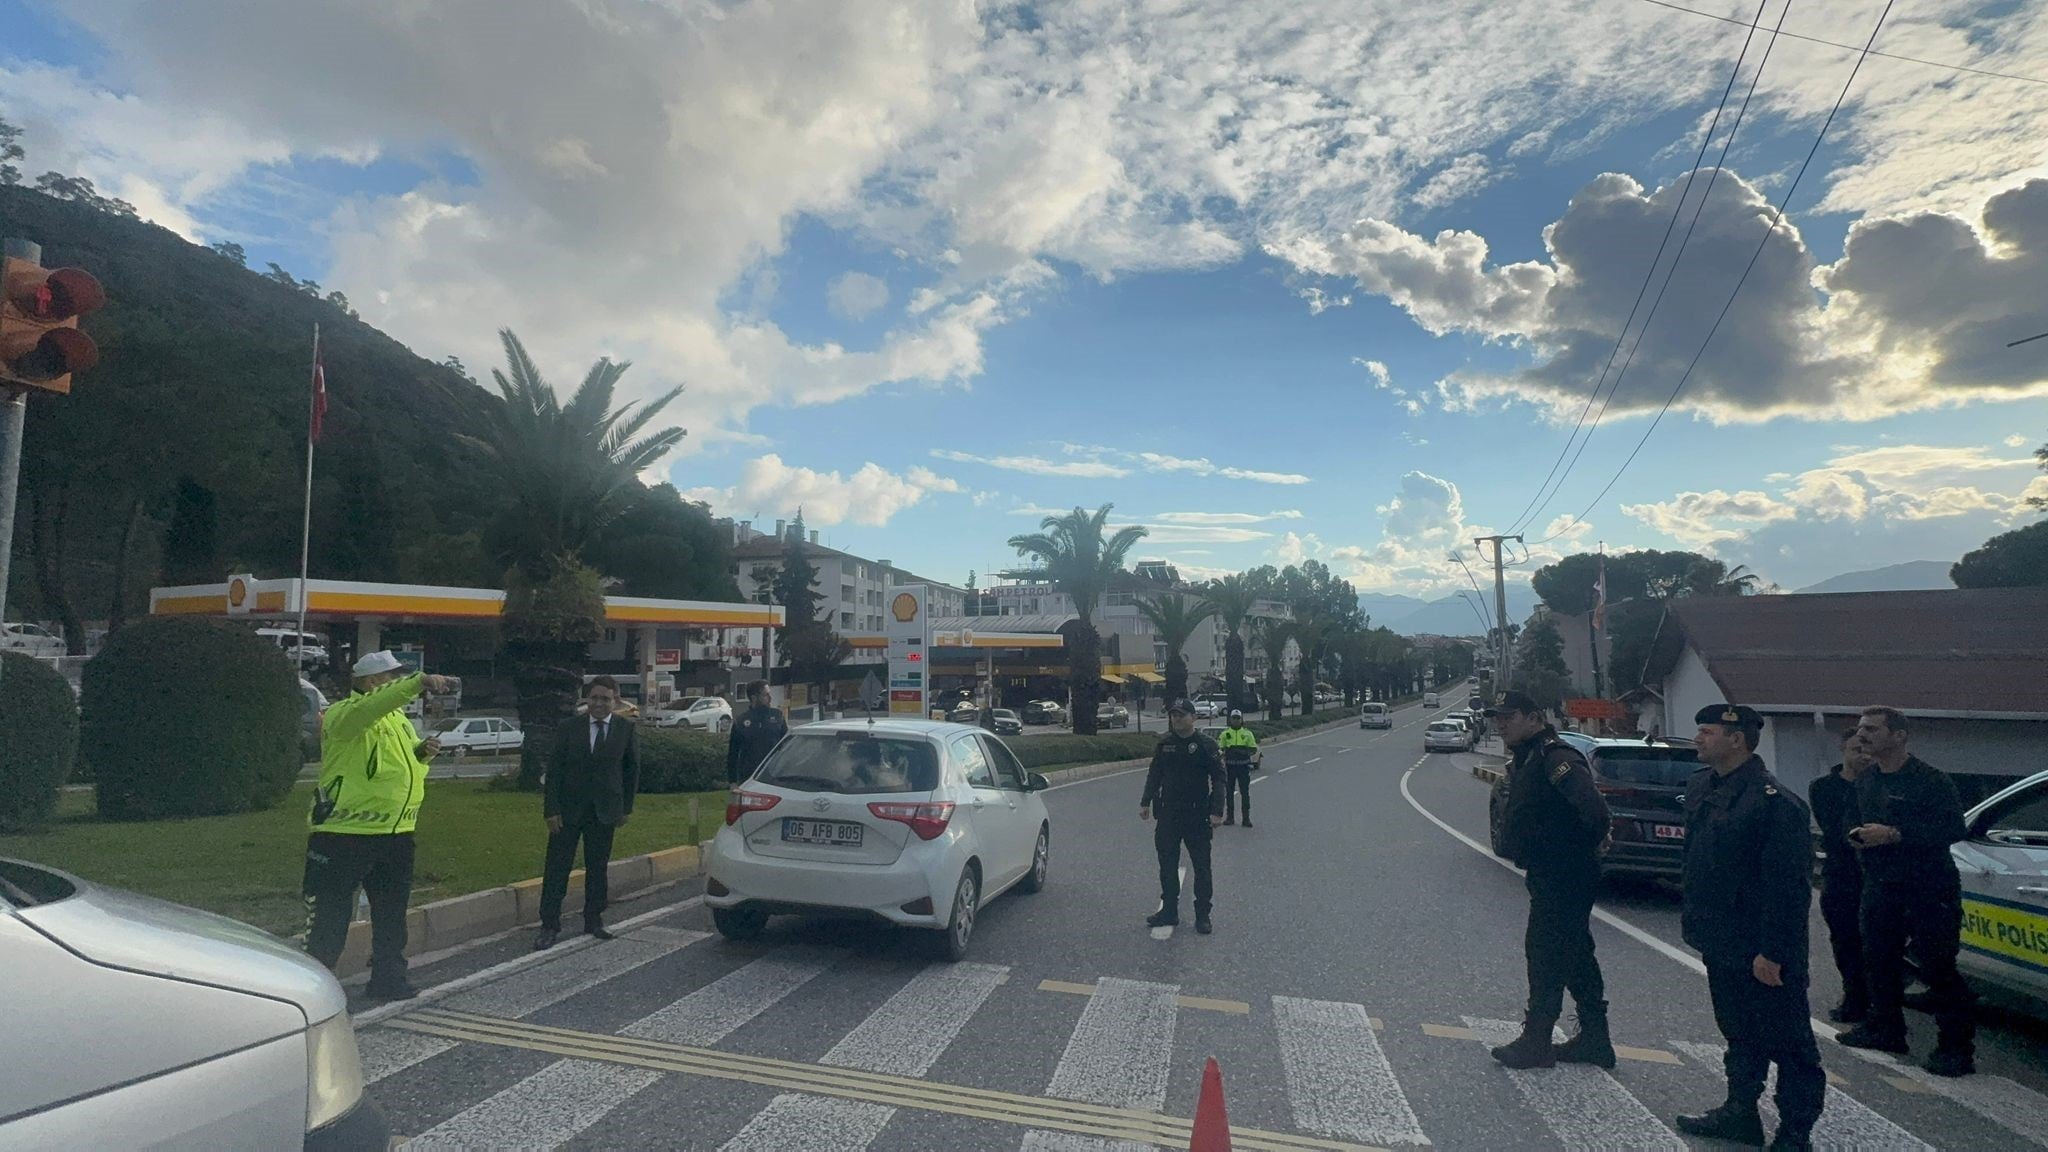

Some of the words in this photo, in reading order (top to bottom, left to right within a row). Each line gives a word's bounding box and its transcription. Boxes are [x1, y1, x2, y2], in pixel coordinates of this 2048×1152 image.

[791, 822, 804, 836] 06
[811, 823, 833, 838] AFB
[838, 825, 859, 840] 805
[1960, 909, 1994, 939] AFİK
[1997, 921, 2048, 955] POLİS
